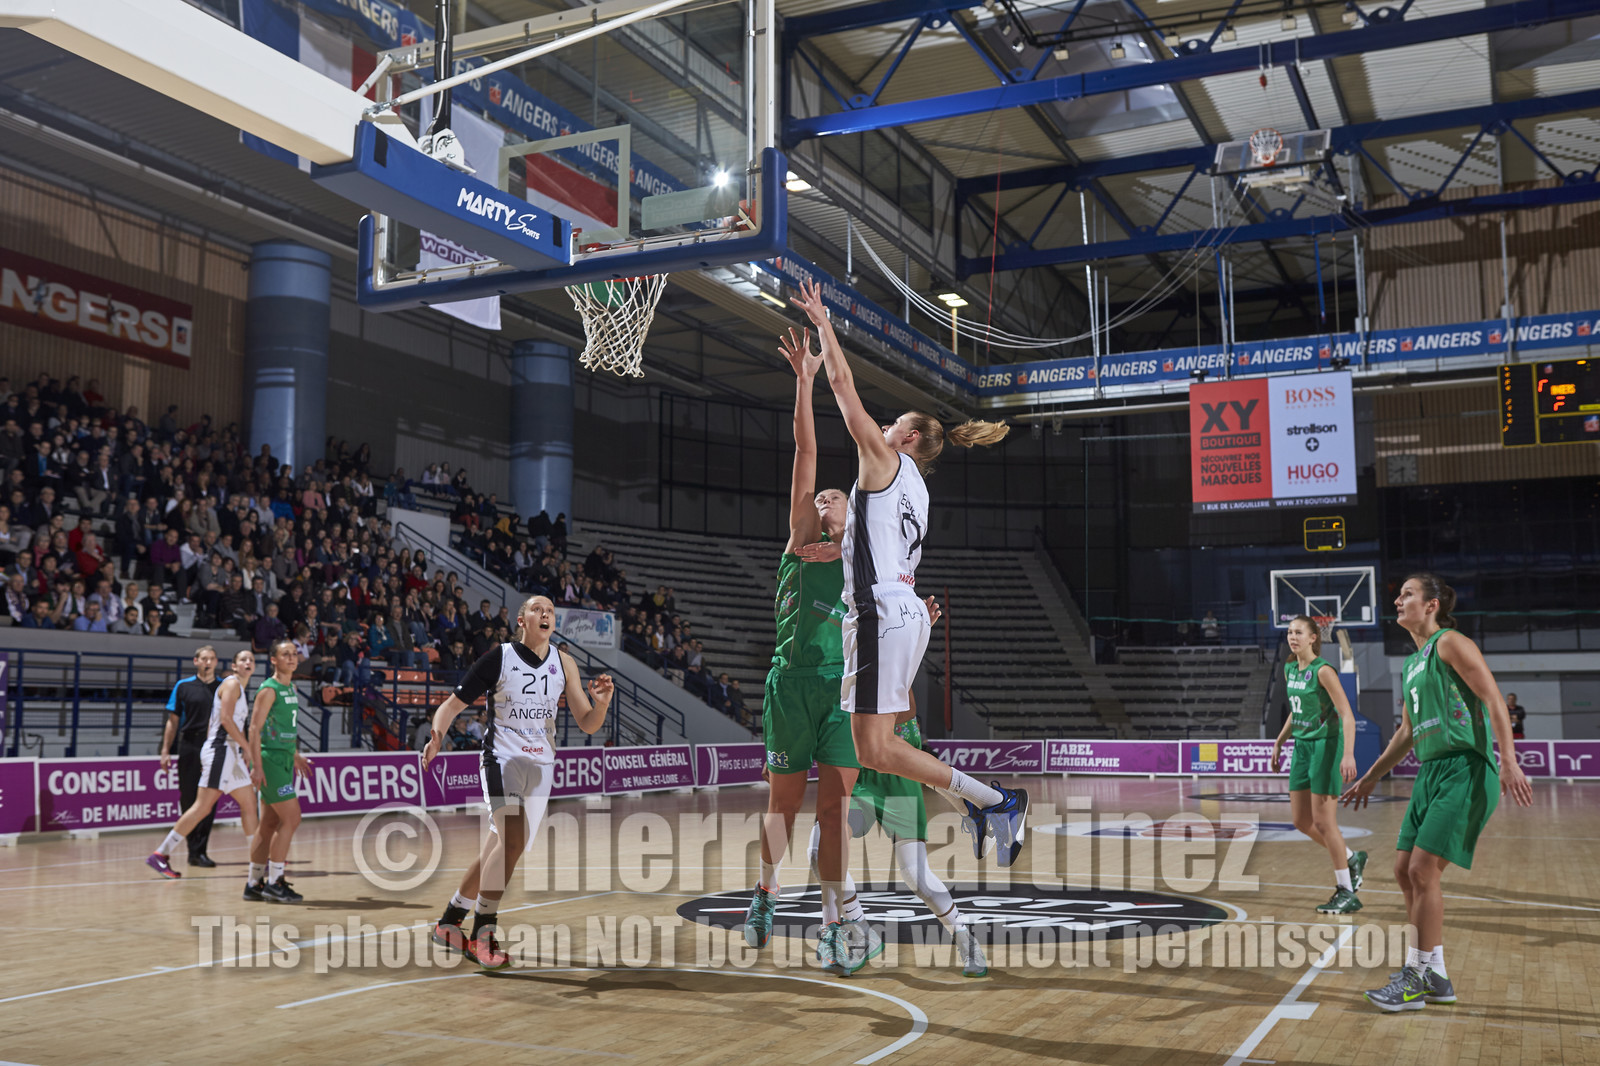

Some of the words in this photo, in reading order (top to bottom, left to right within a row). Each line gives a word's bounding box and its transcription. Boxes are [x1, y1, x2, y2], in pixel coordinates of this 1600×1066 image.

[502, 88, 559, 136] ANGERS
[571, 131, 621, 174] NGERS
[635, 168, 678, 197] ANGER
[457, 187, 517, 226] MARTY
[420, 236, 477, 264] wome
[0, 267, 169, 349] NGERS
[1414, 331, 1482, 350] ANGERS
[1502, 322, 1573, 343] ANGERS
[1251, 346, 1313, 365] ANGERS
[1332, 338, 1397, 357] ANGERS
[1100, 360, 1157, 377] ANGERS
[1174, 352, 1235, 371] ANGERS
[1028, 366, 1085, 384] ANGERS
[1285, 386, 1336, 405] BOSS
[1200, 399, 1260, 433] XY
[1286, 423, 1338, 436] strellson
[1202, 434, 1260, 448] BOUTIQUE
[1201, 453, 1242, 463] DÉCOUVREZ
[1244, 452, 1261, 461] NOS
[1201, 461, 1262, 474] NOUVELLES
[1287, 462, 1339, 480] HUGO
[1201, 472, 1262, 486] MARQUES
[521, 672, 548, 696] 21
[508, 708, 553, 720] ANGERS
[1288, 695, 1303, 714] 12
[521, 745, 544, 753] Géant
[930, 748, 1001, 767] ARTY
[1051, 743, 1093, 756] LABEL
[605, 753, 648, 771] CONSEIL
[649, 750, 689, 768] GÉNÉRAL
[719, 760, 733, 770] PAYS
[733, 760, 740, 769] DE
[740, 759, 749, 769] LA
[748, 757, 763, 768] LOIRE
[1050, 755, 1120, 767] SÉRIGRAPHIE
[1223, 758, 1293, 772] HUTA
[48, 769, 147, 796] CONSEIL
[446, 773, 479, 786] UFAB49
[552, 757, 603, 789] GERS
[622, 777, 633, 788] DE
[632, 773, 679, 788] MAINE-ET-LOIRE
[293, 763, 419, 804] ANGERS
[82, 806, 103, 824] DE
